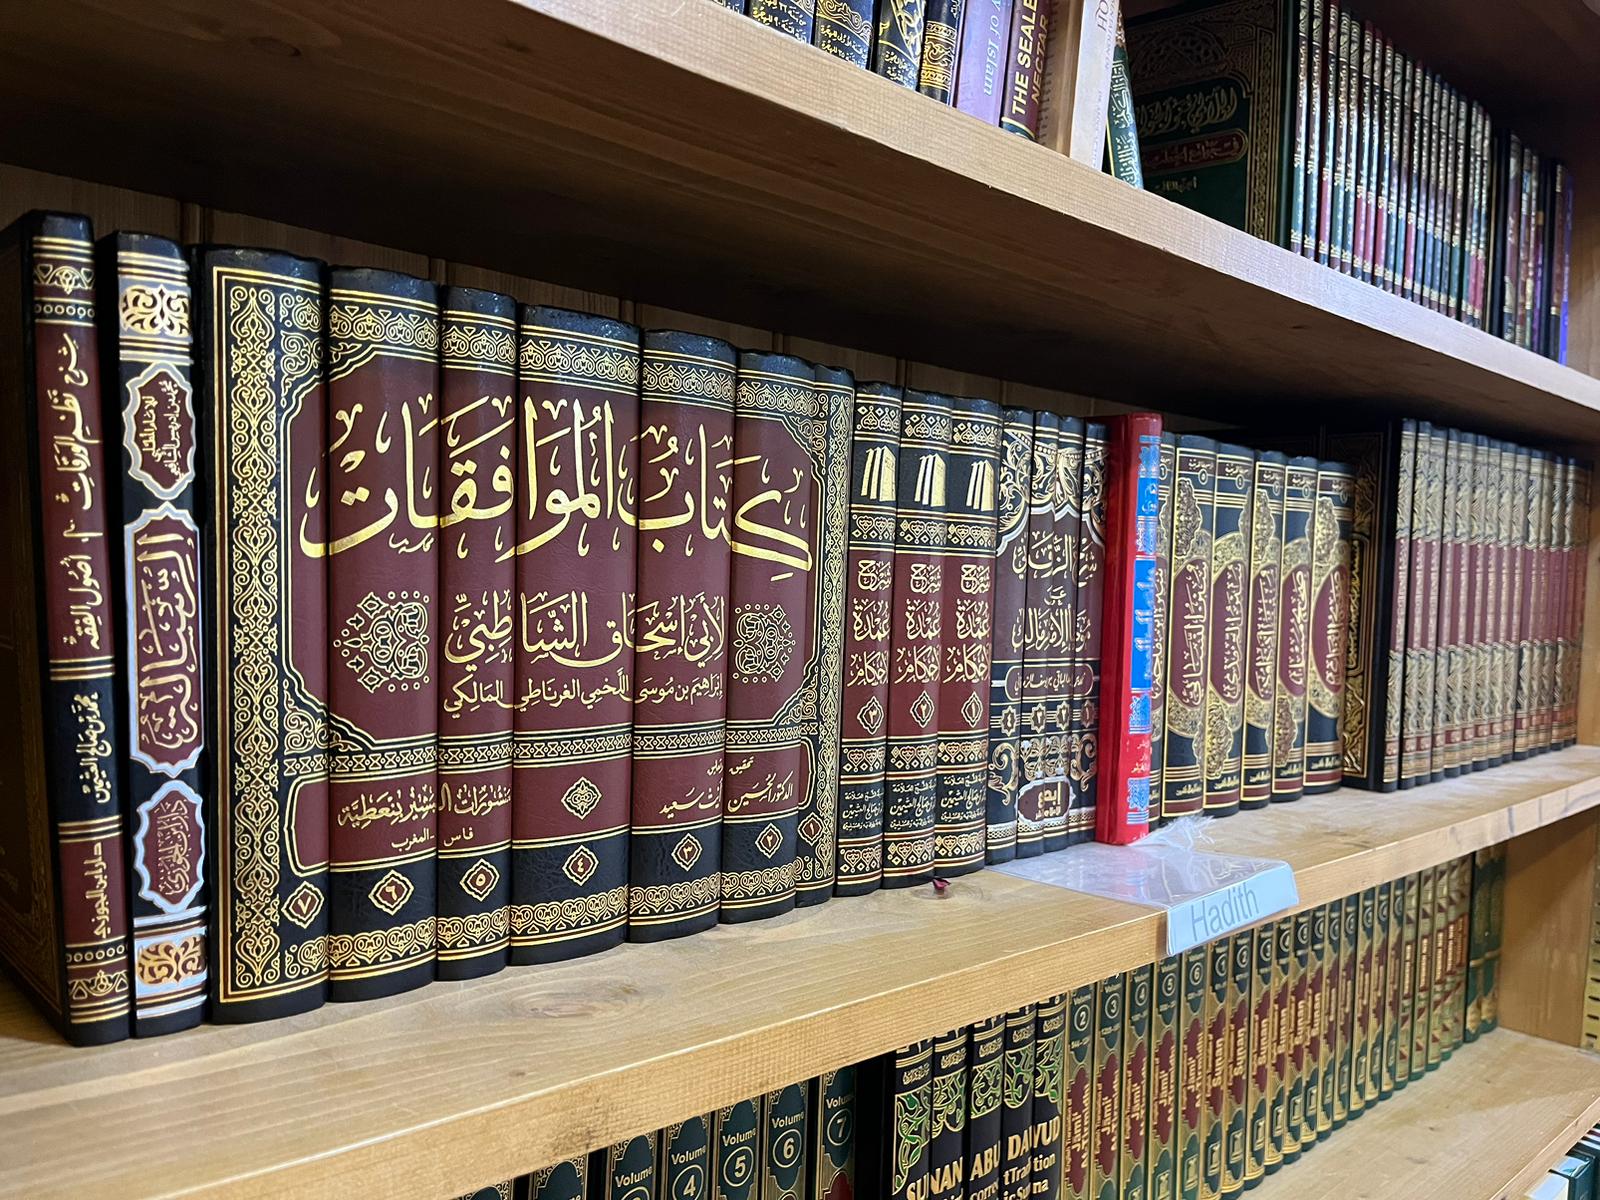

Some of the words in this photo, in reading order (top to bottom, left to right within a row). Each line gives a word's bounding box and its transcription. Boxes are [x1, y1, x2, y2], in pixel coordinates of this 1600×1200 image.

[990, 15, 1001, 38] of
[983, 39, 1000, 97] Islam
[1031, 14, 1049, 105] NECTAR
[1012, 70, 1030, 116] THE
[57, 333, 89, 387] شرح
[299, 393, 616, 564] الموافقات
[618, 424, 813, 583] كتاب
[60, 555, 103, 605] أصول
[857, 559, 892, 592] شرح
[910, 562, 942, 595] شرح
[960, 564, 991, 595] شرح
[62, 604, 103, 650] الفقه
[445, 589, 588, 673] الشاطبي
[683, 591, 726, 670] لأبي
[138, 532, 199, 750] الرسالة
[443, 673, 504, 719] المالكي
[512, 676, 581, 712] الغرناطي
[674, 684, 690, 703] بن
[868, 708, 878, 725] ٣
[919, 702, 928, 720] ٢
[971, 702, 977, 720] ١
[75, 729, 113, 758] صالح
[79, 757, 112, 804] العثيمين
[768, 770, 794, 803] الدكتور
[658, 786, 706, 819] سعيد
[391, 827, 430, 851] المغرب
[443, 826, 475, 847] فاس
[765, 834, 774, 848] ٢
[810, 822, 815, 835] ١
[83, 841, 107, 868] دار
[574, 857, 587, 876] ٤
[683, 846, 693, 860] ٣
[84, 869, 107, 888] ابن
[476, 873, 487, 887] ٥
[299, 895, 311, 914] ٧
[385, 885, 398, 901] ٦
[84, 888, 112, 939] الجوزي
[1190, 884, 1259, 943] Hadith
[1166, 978, 1173, 991] 5
[1193, 967, 1200, 981] 6
[1110, 1000, 1117, 1014] 3
[1139, 989, 1145, 1003] 4
[1079, 1011, 1086, 1026] 2
[1310, 992, 1321, 1037] Sunan
[1258, 1017, 1270, 1066] Sunan
[1277, 1007, 1288, 1054] Sunan
[1212, 1037, 1225, 1088] Sunan
[1233, 1027, 1246, 1077] Sunan
[771, 1110, 804, 1129] Volume
[835, 1116, 847, 1138] 7
[722, 1126, 757, 1147] Volume
[783, 1137, 794, 1159] 6
[671, 1144, 706, 1166] Volume
[734, 1155, 747, 1178] 5
[969, 1140, 1001, 1182] ABU
[615, 1165, 653, 1189] Volume
[683, 1175, 696, 1197] 4
